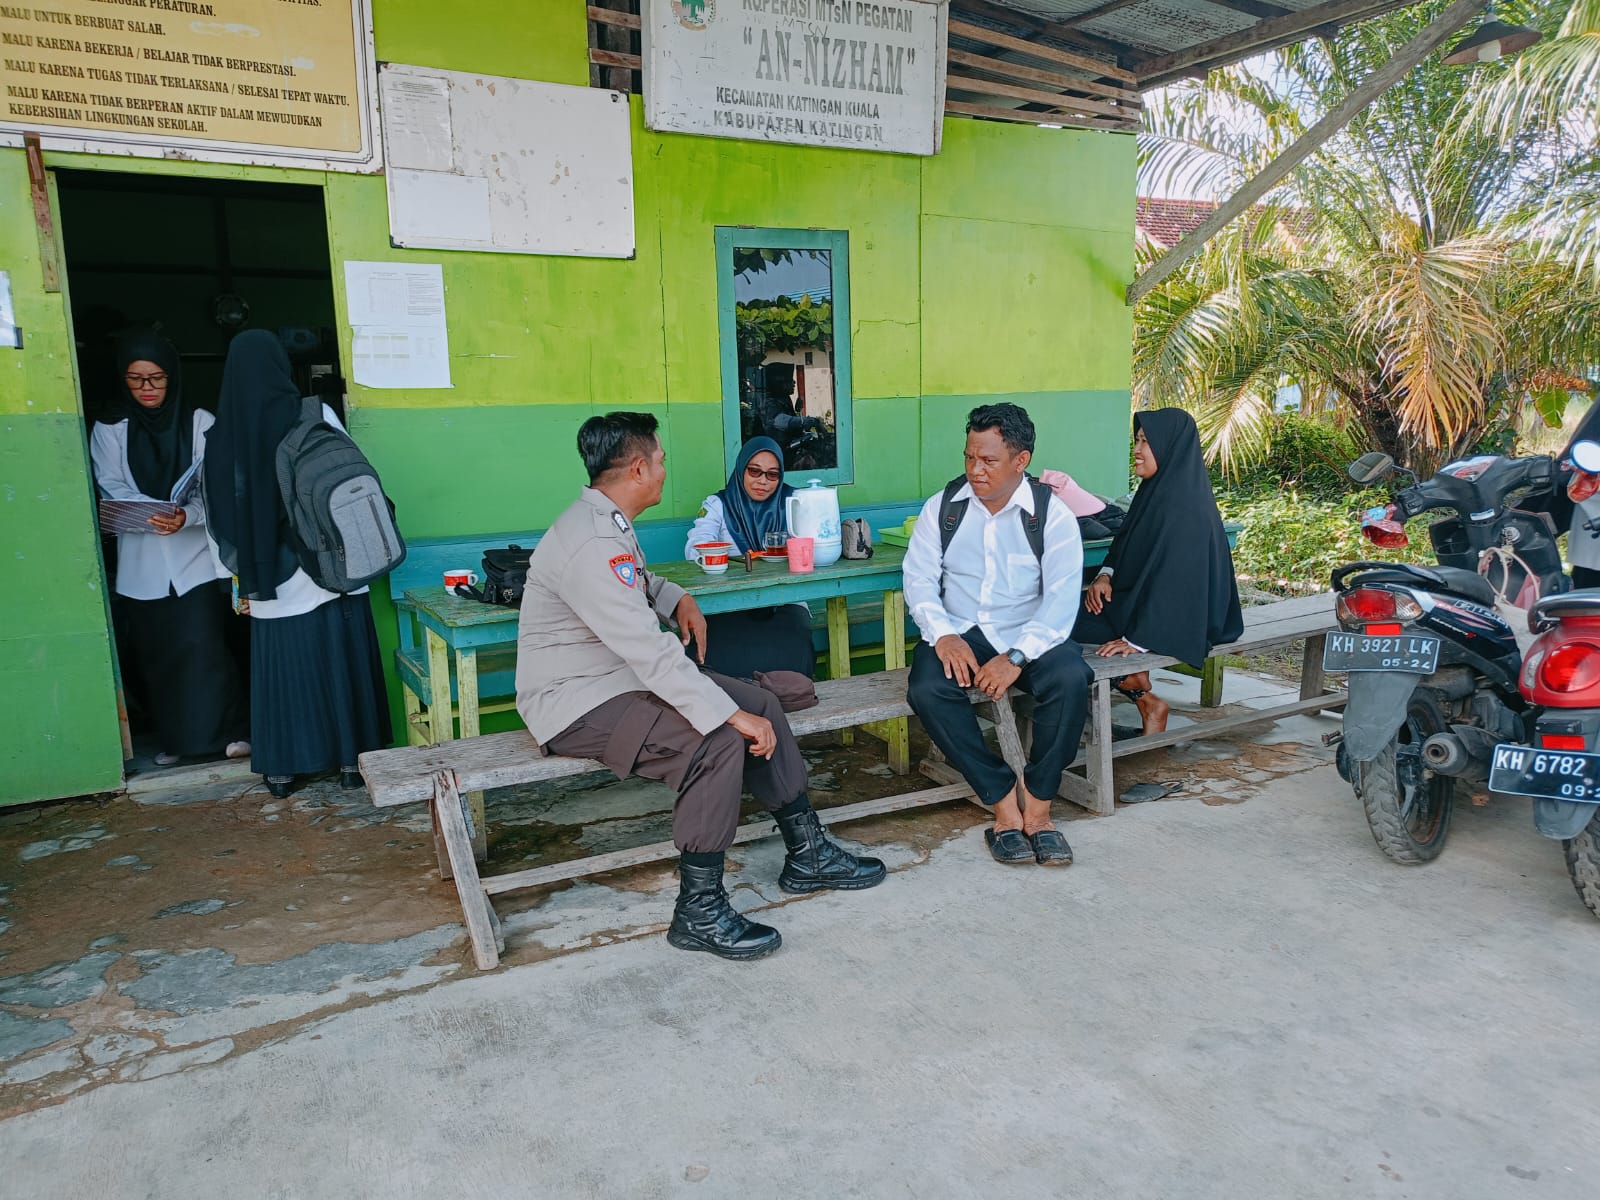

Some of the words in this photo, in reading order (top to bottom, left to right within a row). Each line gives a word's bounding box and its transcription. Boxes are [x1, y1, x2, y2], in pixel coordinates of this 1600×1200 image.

[0, 6, 31, 20] MALU
[33, 9, 72, 25] UNTUK
[75, 14, 125, 31] BERBUAT
[128, 22, 166, 36] SALAH.
[150, 0, 216, 17] PERATURAN.
[815, 0, 851, 25] MTsN
[856, 1, 912, 33] PEGATAN
[2, 33, 33, 47] MALU
[36, 36, 82, 52] KARENA
[84, 41, 134, 58] BEKERJA
[143, 48, 191, 64] BELAJAR
[192, 53, 224, 68] TIDAK
[226, 57, 296, 76] BERPRESTASI.
[4, 59, 36, 73] MALU
[38, 62, 85, 78] KARENA
[87, 67, 122, 82] TUGAS
[125, 71, 158, 86] TIDAK
[160, 75, 229, 93] TERLAKSANA
[237, 84, 279, 99] SELESAI
[281, 89, 311, 102] TEPAT
[314, 92, 350, 106] WAKTU.
[7, 85, 38, 99] MALU
[41, 88, 88, 104] KARENA
[90, 93, 123, 108] TIDAK
[126, 97, 183, 114] BERPERAN
[187, 103, 217, 117] AKTIF
[220, 106, 254, 121] DALAM
[256, 110, 322, 127] MEWUJUDKAN
[9, 102, 82, 121] KEBERSIHAN
[85, 110, 154, 128] LINGKUNGAN
[157, 117, 208, 133] SEKOLAH.
[716, 86, 783, 109] KECAMATAN
[787, 95, 842, 116] KATINGAN
[845, 101, 879, 119] KUALA
[713, 110, 803, 134] KABUPATEN
[809, 119, 883, 142] KATINGAN
[1331, 635, 1354, 653] KH
[1361, 638, 1400, 653] 3921
[1409, 639, 1433, 655] LK
[1496, 749, 1524, 770] KH
[1534, 754, 1586, 777] 6782
